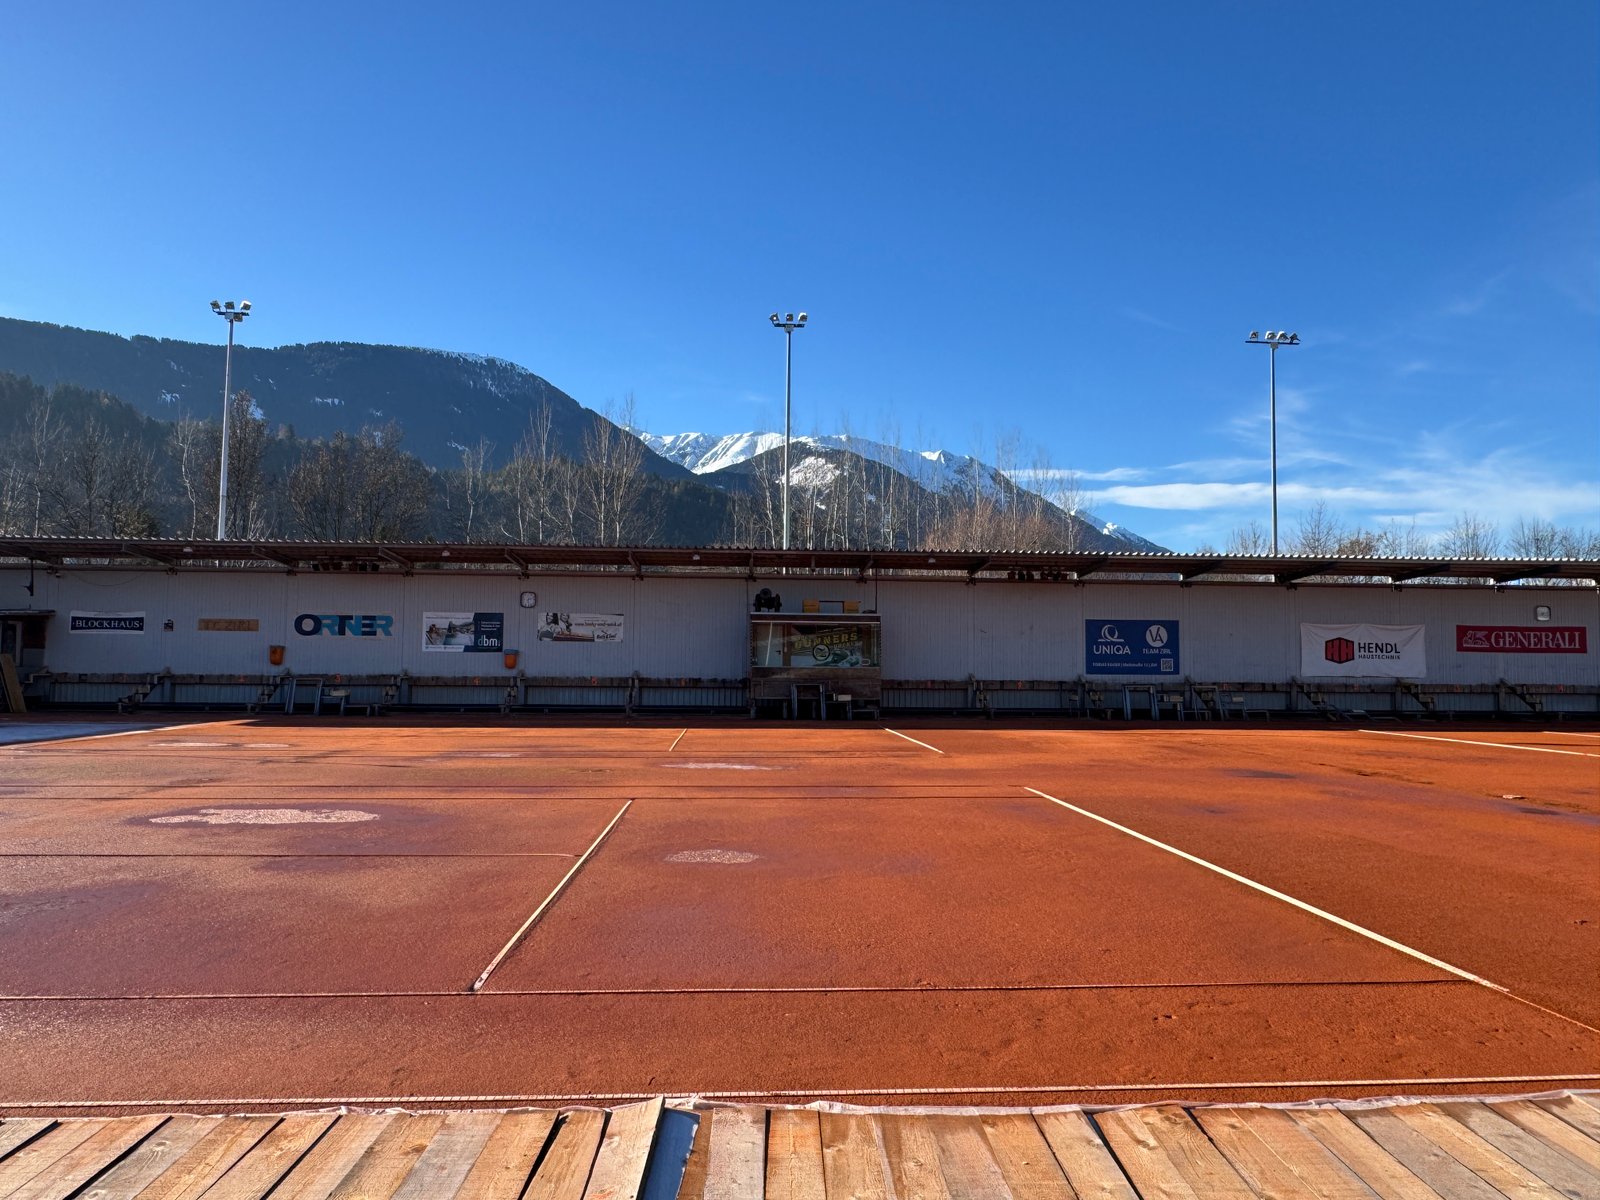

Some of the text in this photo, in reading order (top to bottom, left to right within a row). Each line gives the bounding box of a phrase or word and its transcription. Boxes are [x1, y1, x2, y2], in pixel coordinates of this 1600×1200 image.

[75, 619, 140, 629] BLOCKHAUS
[294, 613, 393, 636] ORTNER
[1490, 631, 1581, 649] GENERALI
[1093, 644, 1131, 655] UNIQA
[1358, 642, 1401, 654] HENDL
